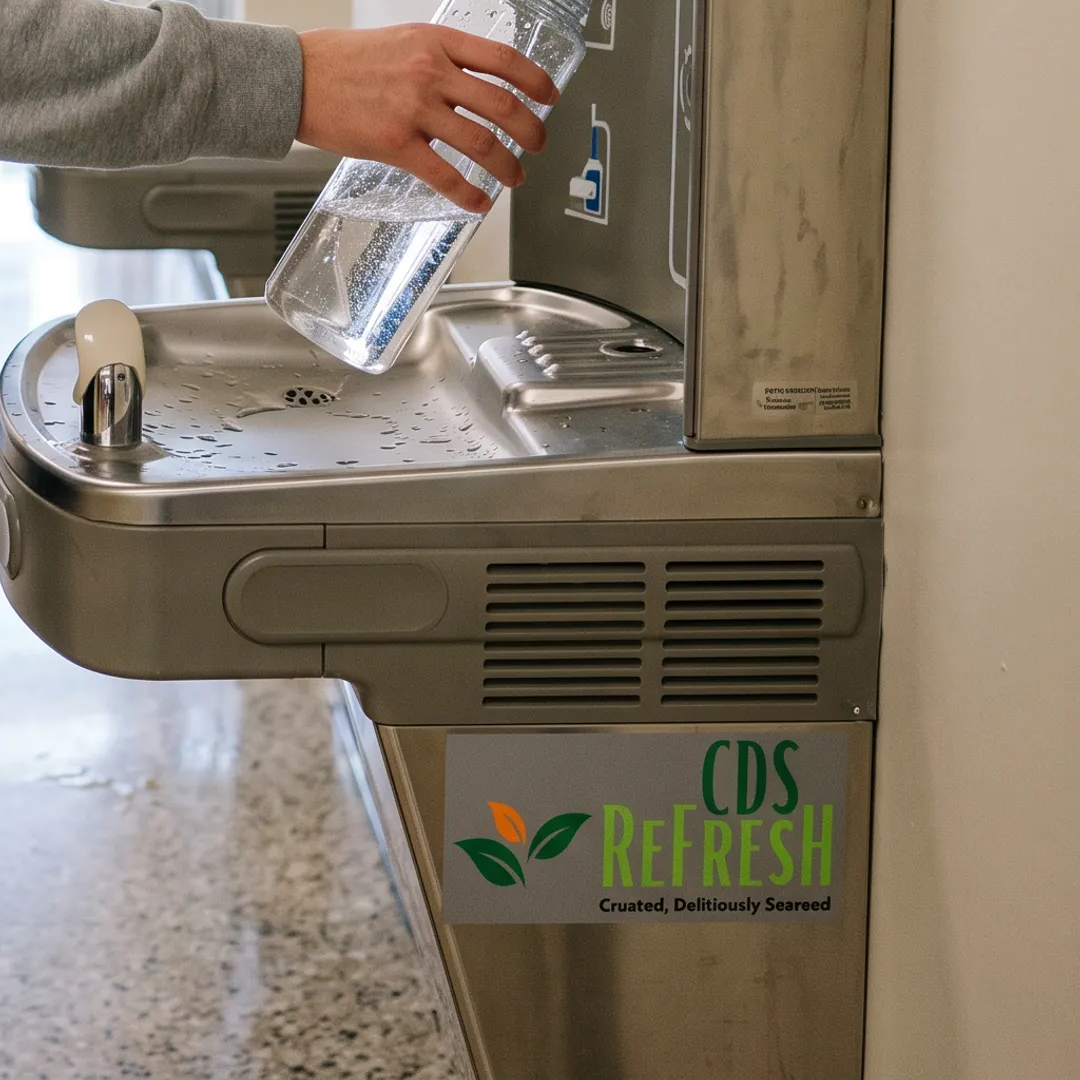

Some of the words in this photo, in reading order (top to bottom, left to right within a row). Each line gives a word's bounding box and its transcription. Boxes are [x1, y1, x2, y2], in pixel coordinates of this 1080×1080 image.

[702, 740, 799, 815] CDS
[599, 898, 669, 914] Cruated,
[674, 897, 761, 915] Delitiously
[765, 896, 831, 912] Seareed
